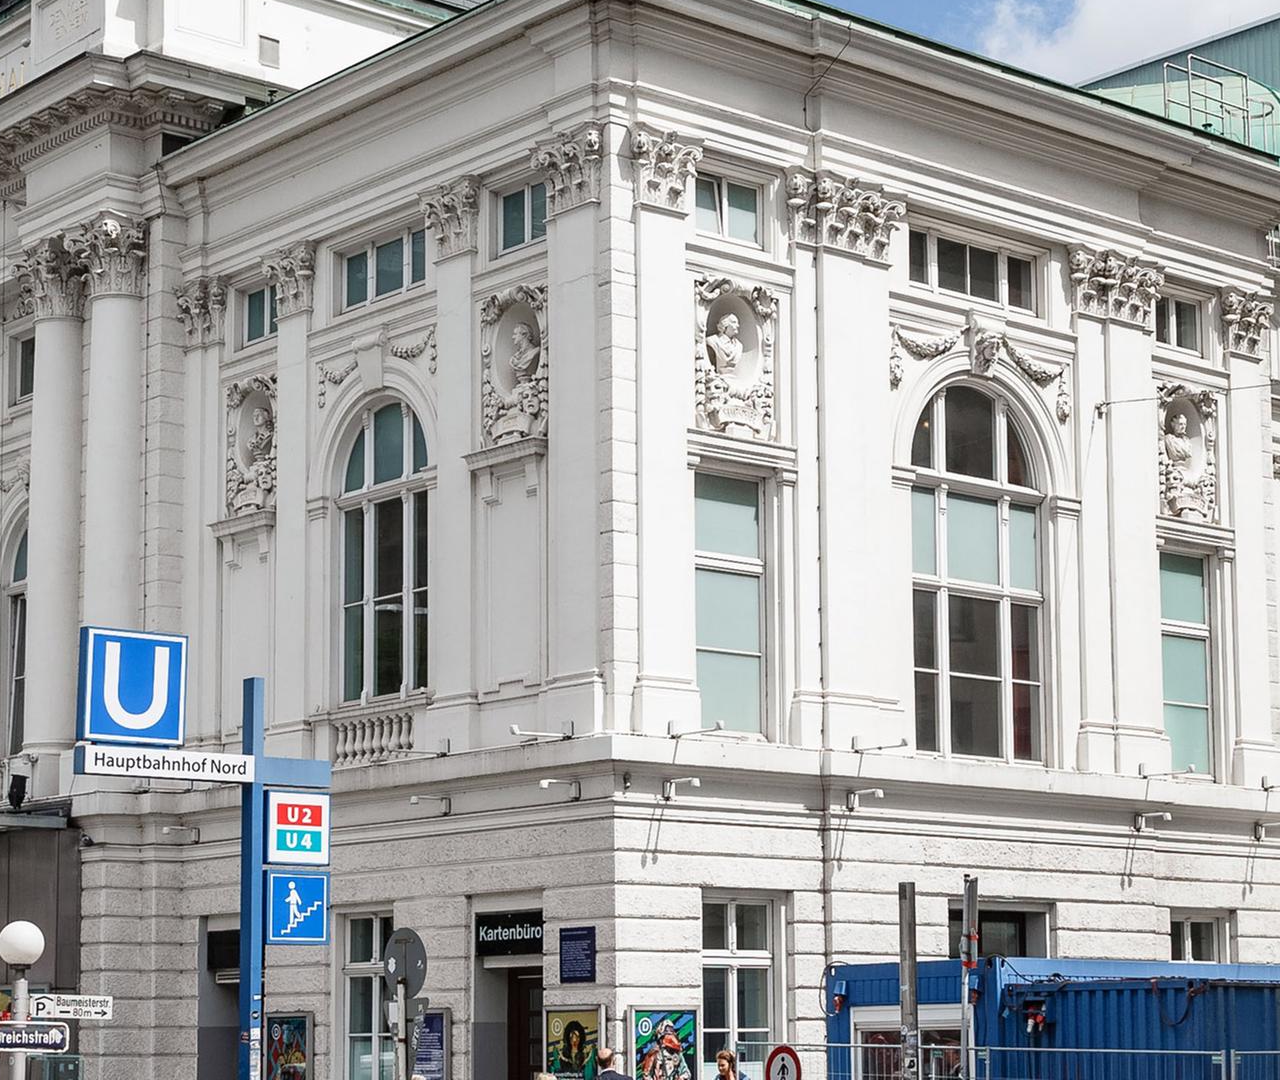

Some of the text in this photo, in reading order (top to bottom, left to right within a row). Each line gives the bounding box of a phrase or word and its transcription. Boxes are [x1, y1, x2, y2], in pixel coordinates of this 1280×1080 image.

[104, 641, 170, 730] U
[94, 752, 247, 775] Hauptbahnhof Nord
[479, 923, 542, 941] Kartenbüro
[56, 996, 111, 1008] Baumeisterstr.
